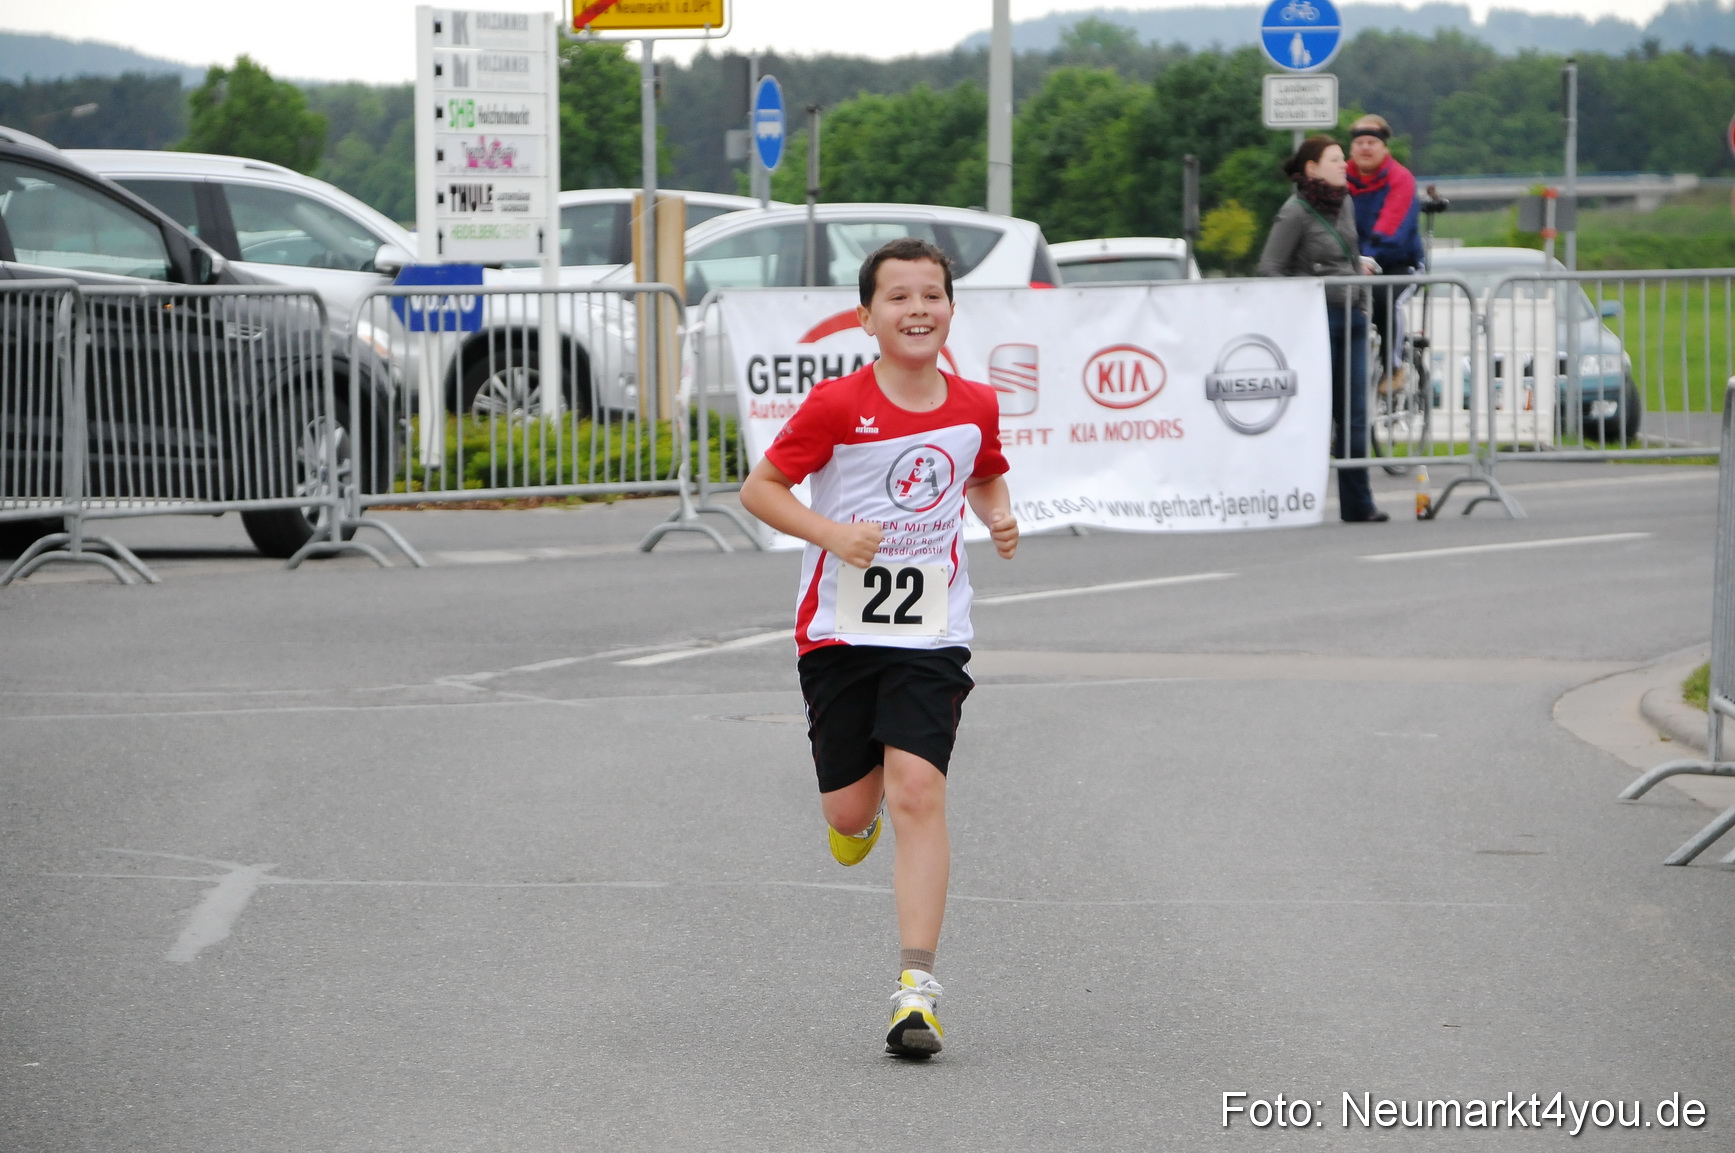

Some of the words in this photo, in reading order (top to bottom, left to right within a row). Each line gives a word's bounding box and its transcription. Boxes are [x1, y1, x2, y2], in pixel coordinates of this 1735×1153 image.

[615, 1, 670, 13] Neumarkt
[449, 99, 475, 128] SHB
[449, 183, 493, 212] THULE
[1098, 360, 1150, 394] KIA
[1216, 376, 1289, 394] NISSAN
[749, 399, 801, 419] Autoh
[855, 426, 879, 434] erima
[999, 427, 1054, 446] EAT
[1069, 422, 1099, 443] KIA
[1103, 417, 1185, 442] MOTORS
[1106, 487, 1316, 524] www.gerhart-jaenig.de
[861, 565, 924, 625] 22
